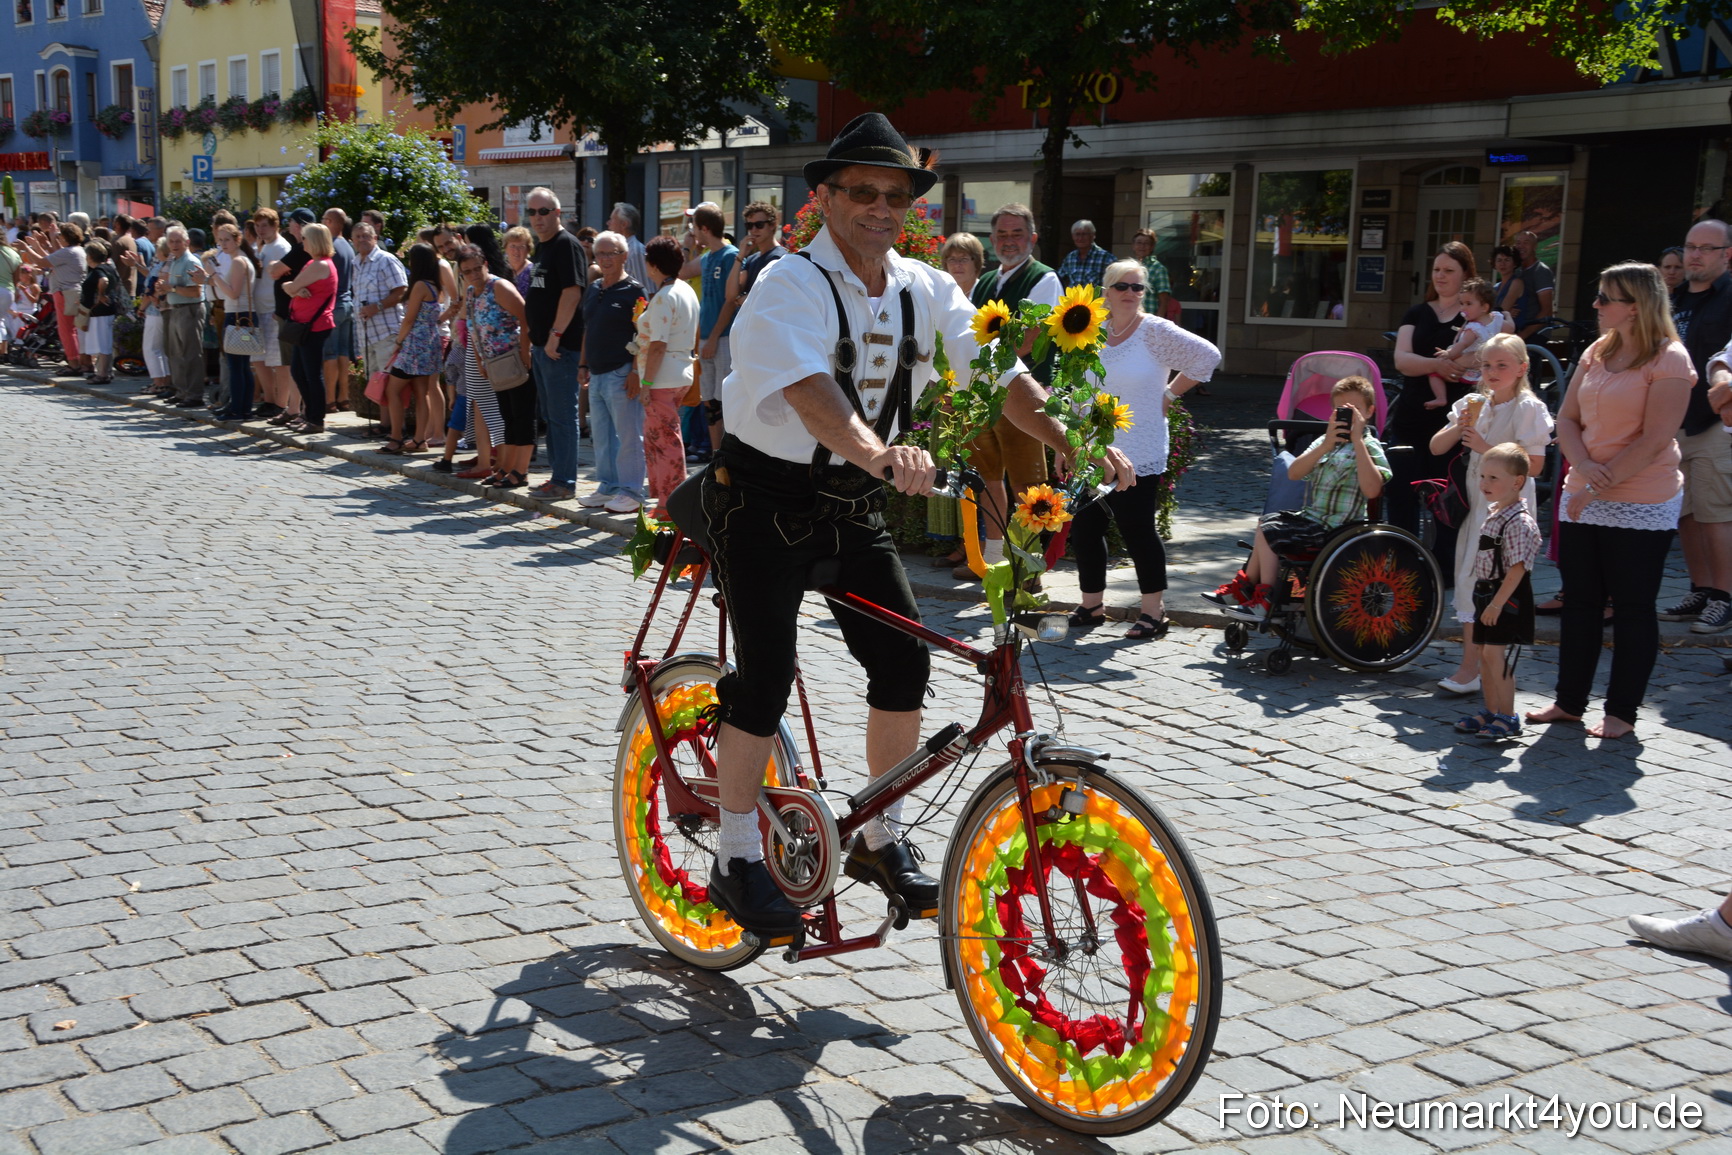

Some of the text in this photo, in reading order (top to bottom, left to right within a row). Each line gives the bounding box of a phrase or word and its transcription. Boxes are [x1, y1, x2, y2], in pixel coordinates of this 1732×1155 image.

[196, 158, 209, 180] P
[713, 266, 722, 279] 2
[891, 761, 930, 791] HERCULES
